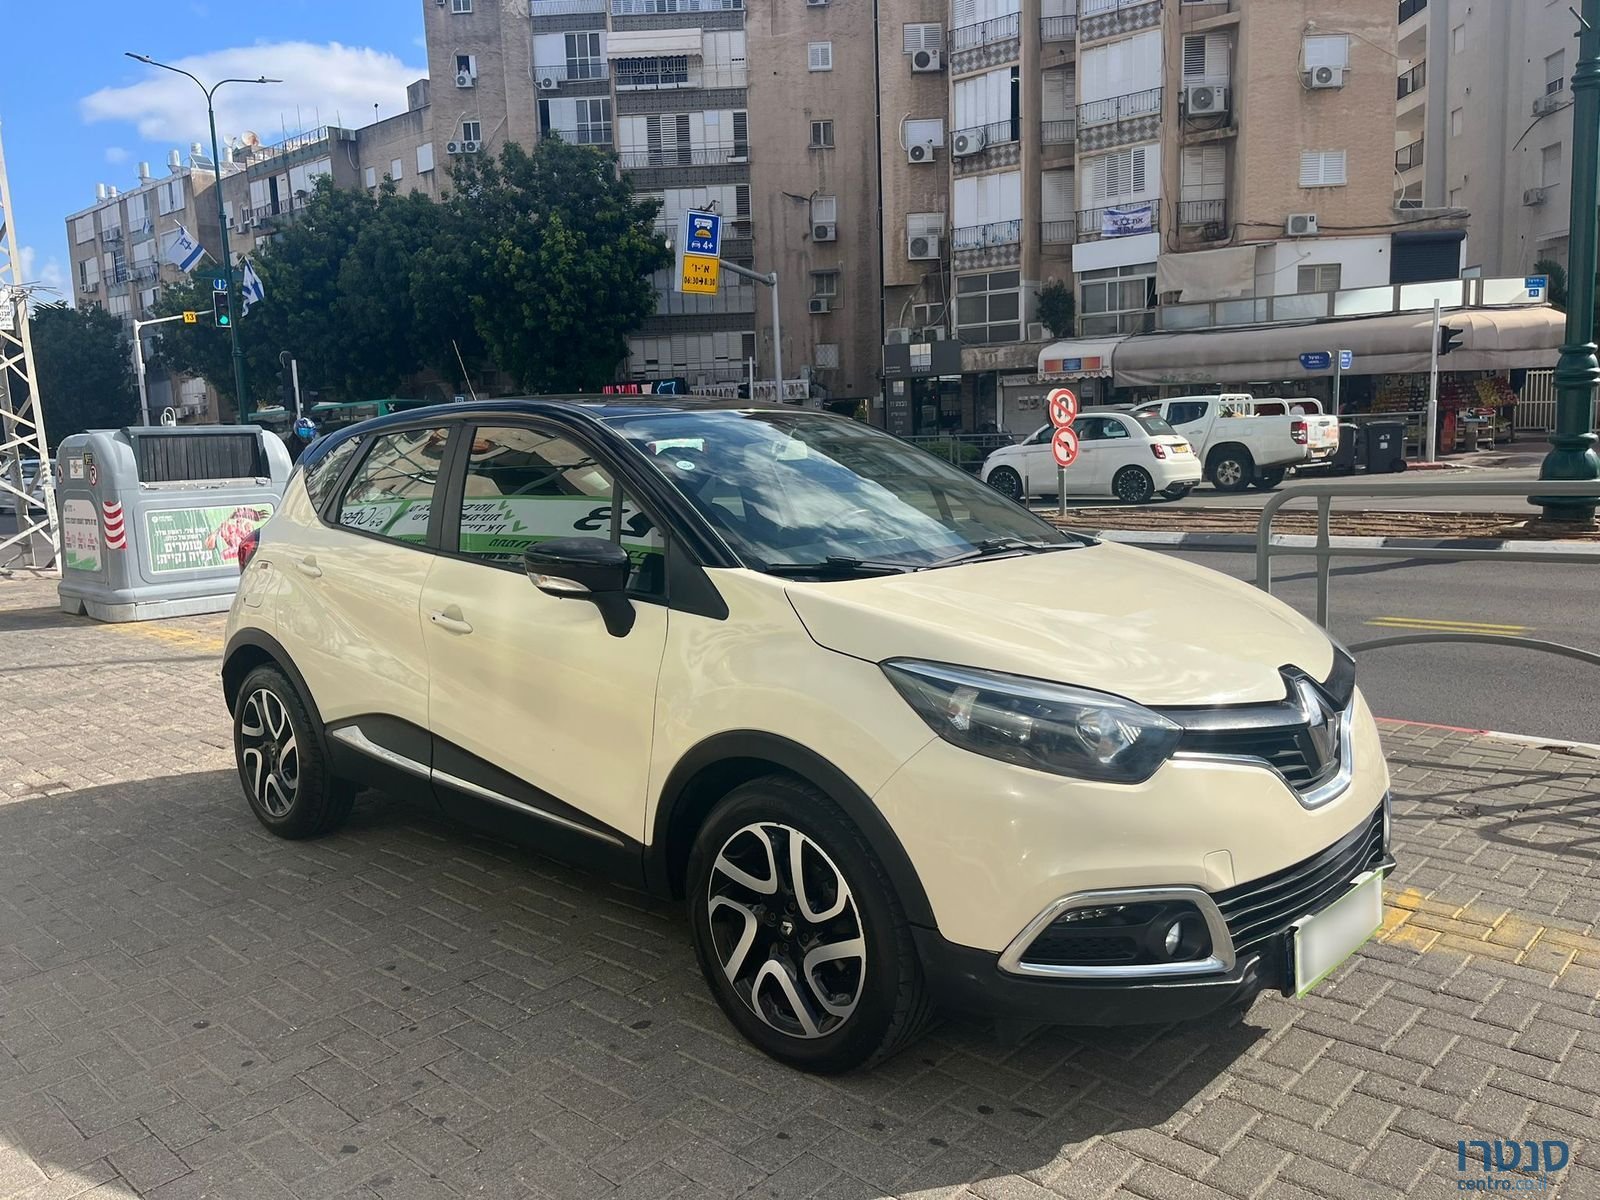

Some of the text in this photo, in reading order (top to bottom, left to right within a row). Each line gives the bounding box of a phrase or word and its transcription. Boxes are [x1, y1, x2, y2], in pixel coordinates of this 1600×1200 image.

[702, 240, 714, 250] 4+
[186, 313, 195, 321] 13
[164, 540, 203, 553] שומרים
[156, 550, 213, 565] עליה נקייה!
